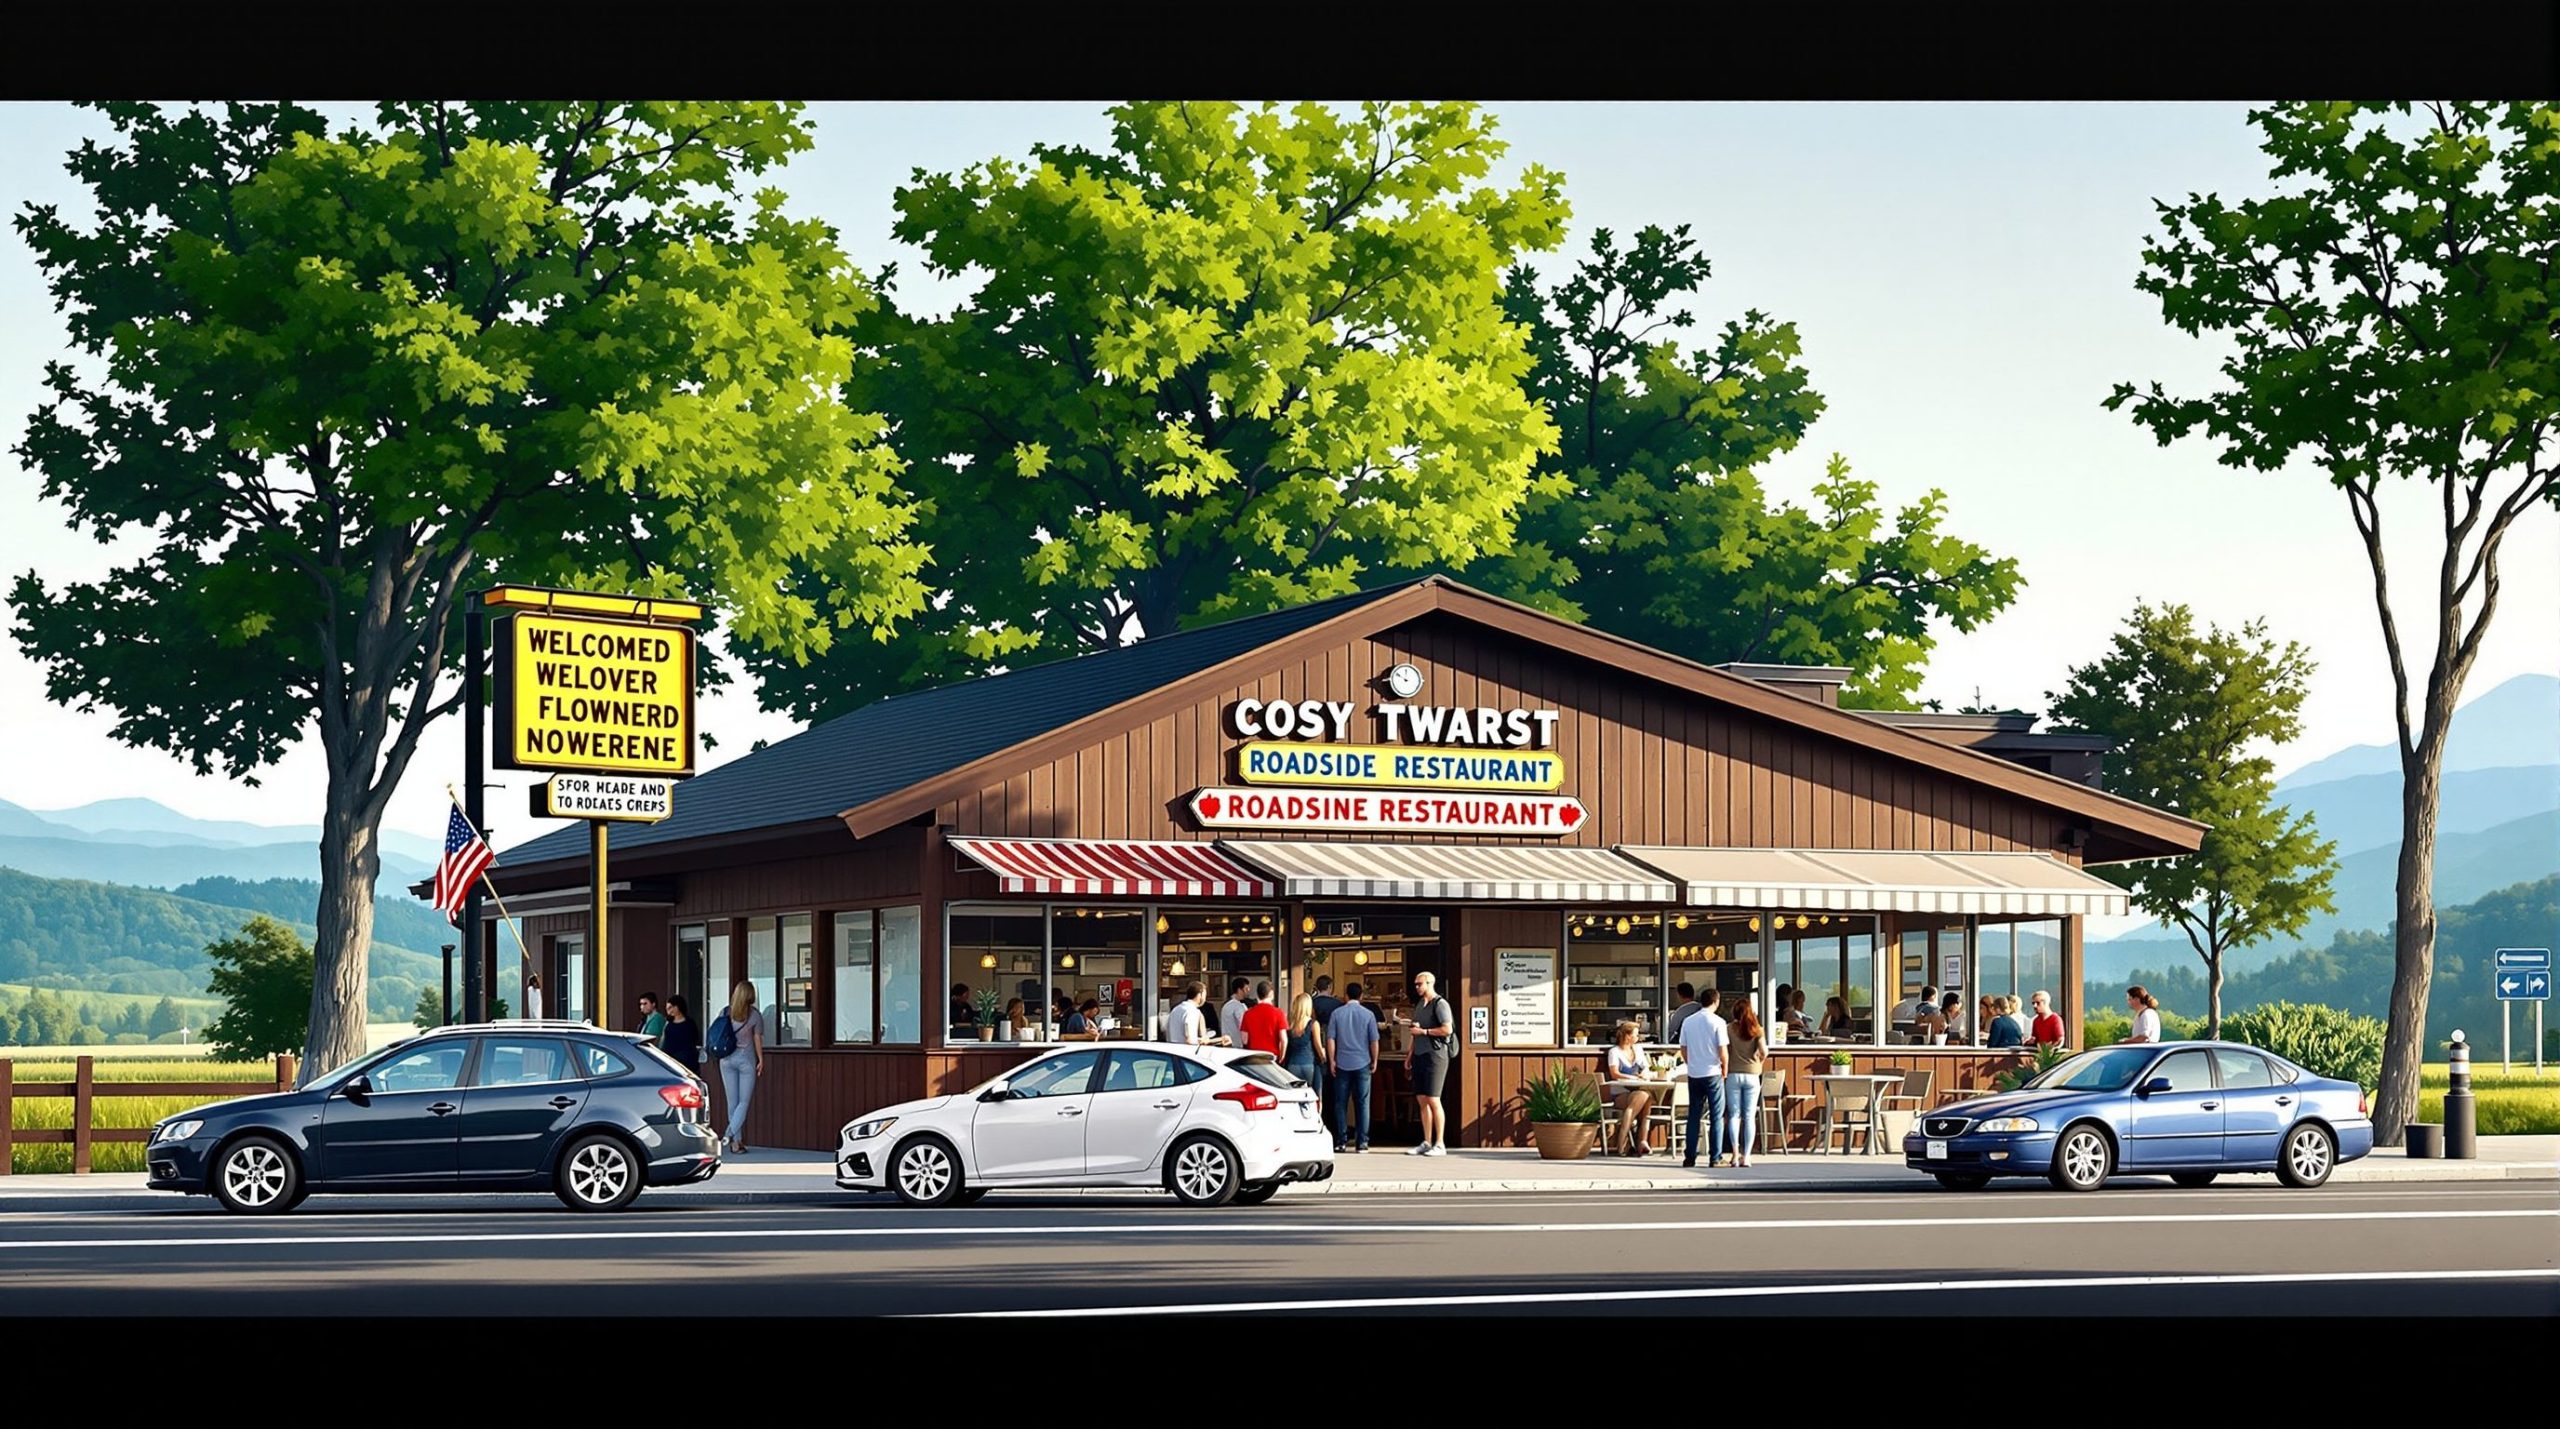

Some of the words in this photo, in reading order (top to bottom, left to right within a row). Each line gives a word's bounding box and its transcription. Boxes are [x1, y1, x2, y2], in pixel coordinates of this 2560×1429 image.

[528, 627, 670, 663] WELCOMED
[536, 661, 657, 695] WELOVER
[539, 695, 679, 729] FLOWNERD
[1234, 697, 1355, 739] COSY
[1378, 703, 1559, 746] TWARST
[527, 727, 676, 762] NOWERENE
[1250, 749, 1376, 778] ROADSIDE
[1395, 756, 1553, 782] RESTAURANT
[558, 796, 572, 808] TO
[640, 784, 665, 796] AND
[1229, 795, 1368, 821] ROADSINE
[1380, 798, 1554, 826] RESTAURANT
